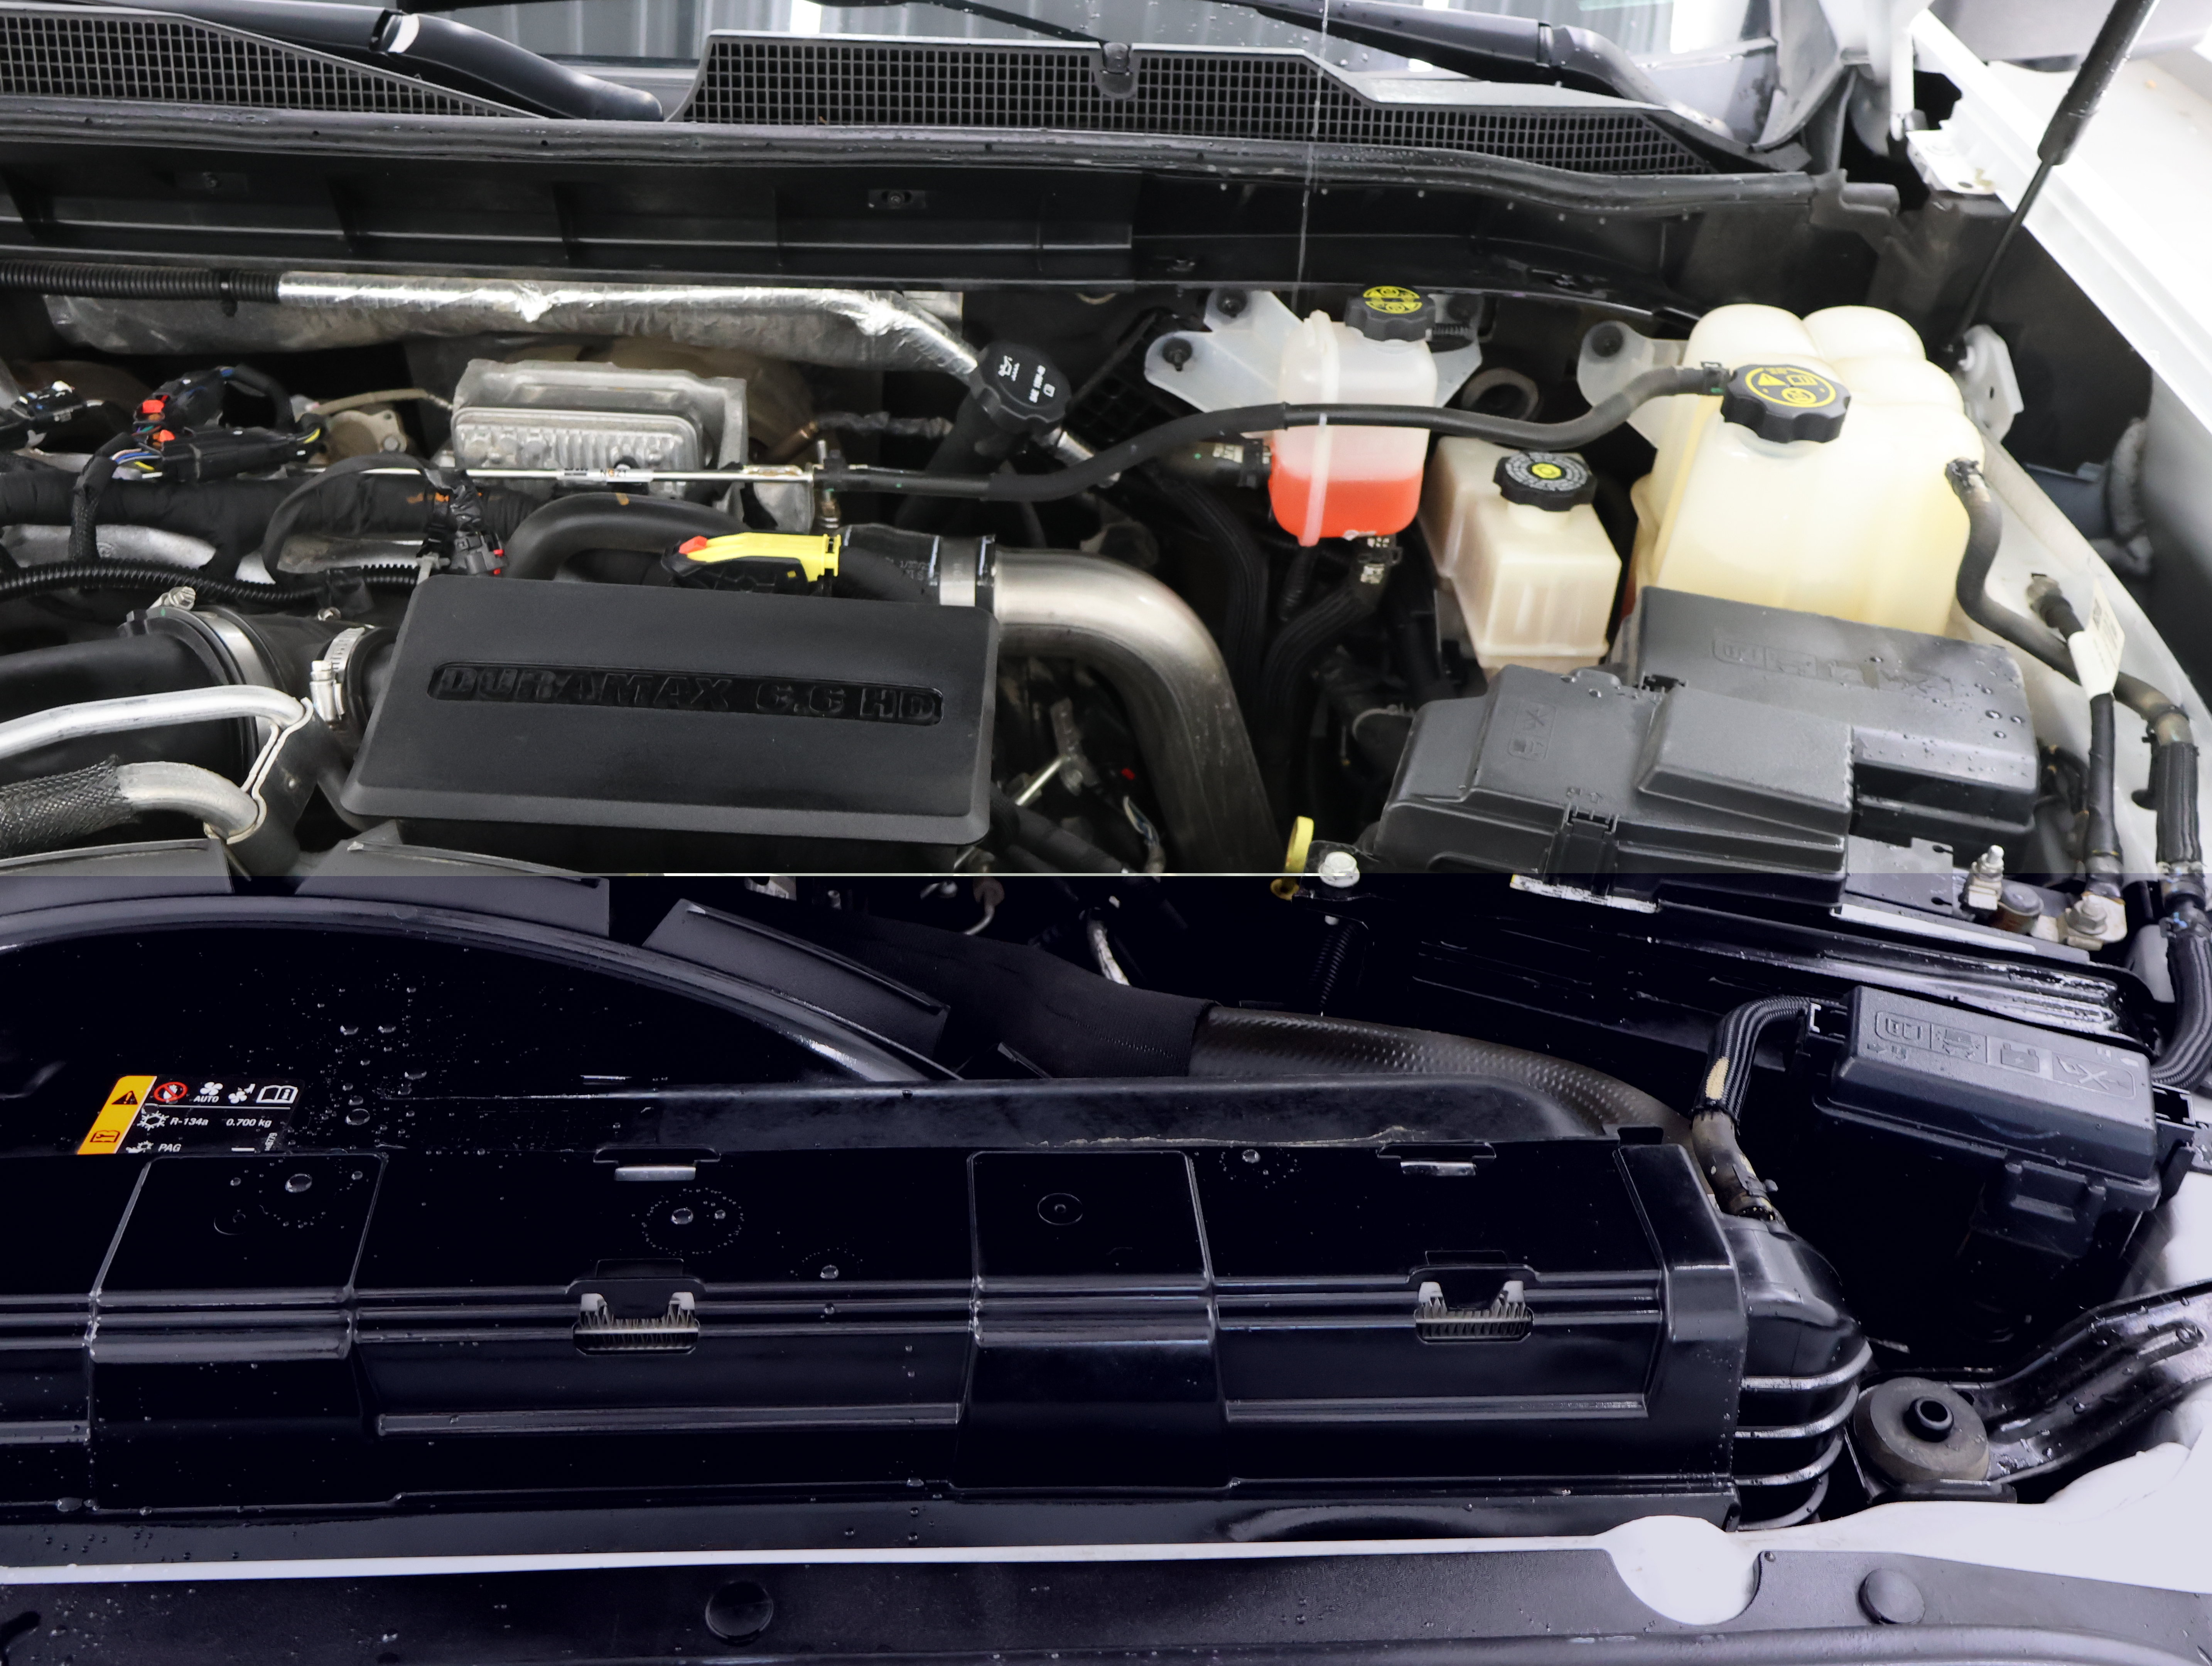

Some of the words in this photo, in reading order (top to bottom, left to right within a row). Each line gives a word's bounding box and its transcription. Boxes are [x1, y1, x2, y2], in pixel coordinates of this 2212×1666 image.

[436, 668, 732, 709] DURAMAX
[756, 681, 845, 716] 6.6
[859, 688, 936, 722] HD
[170, 1117, 209, 1125] R-134a
[258, 1119, 272, 1128] kg
[158, 1143, 182, 1152] PAG
